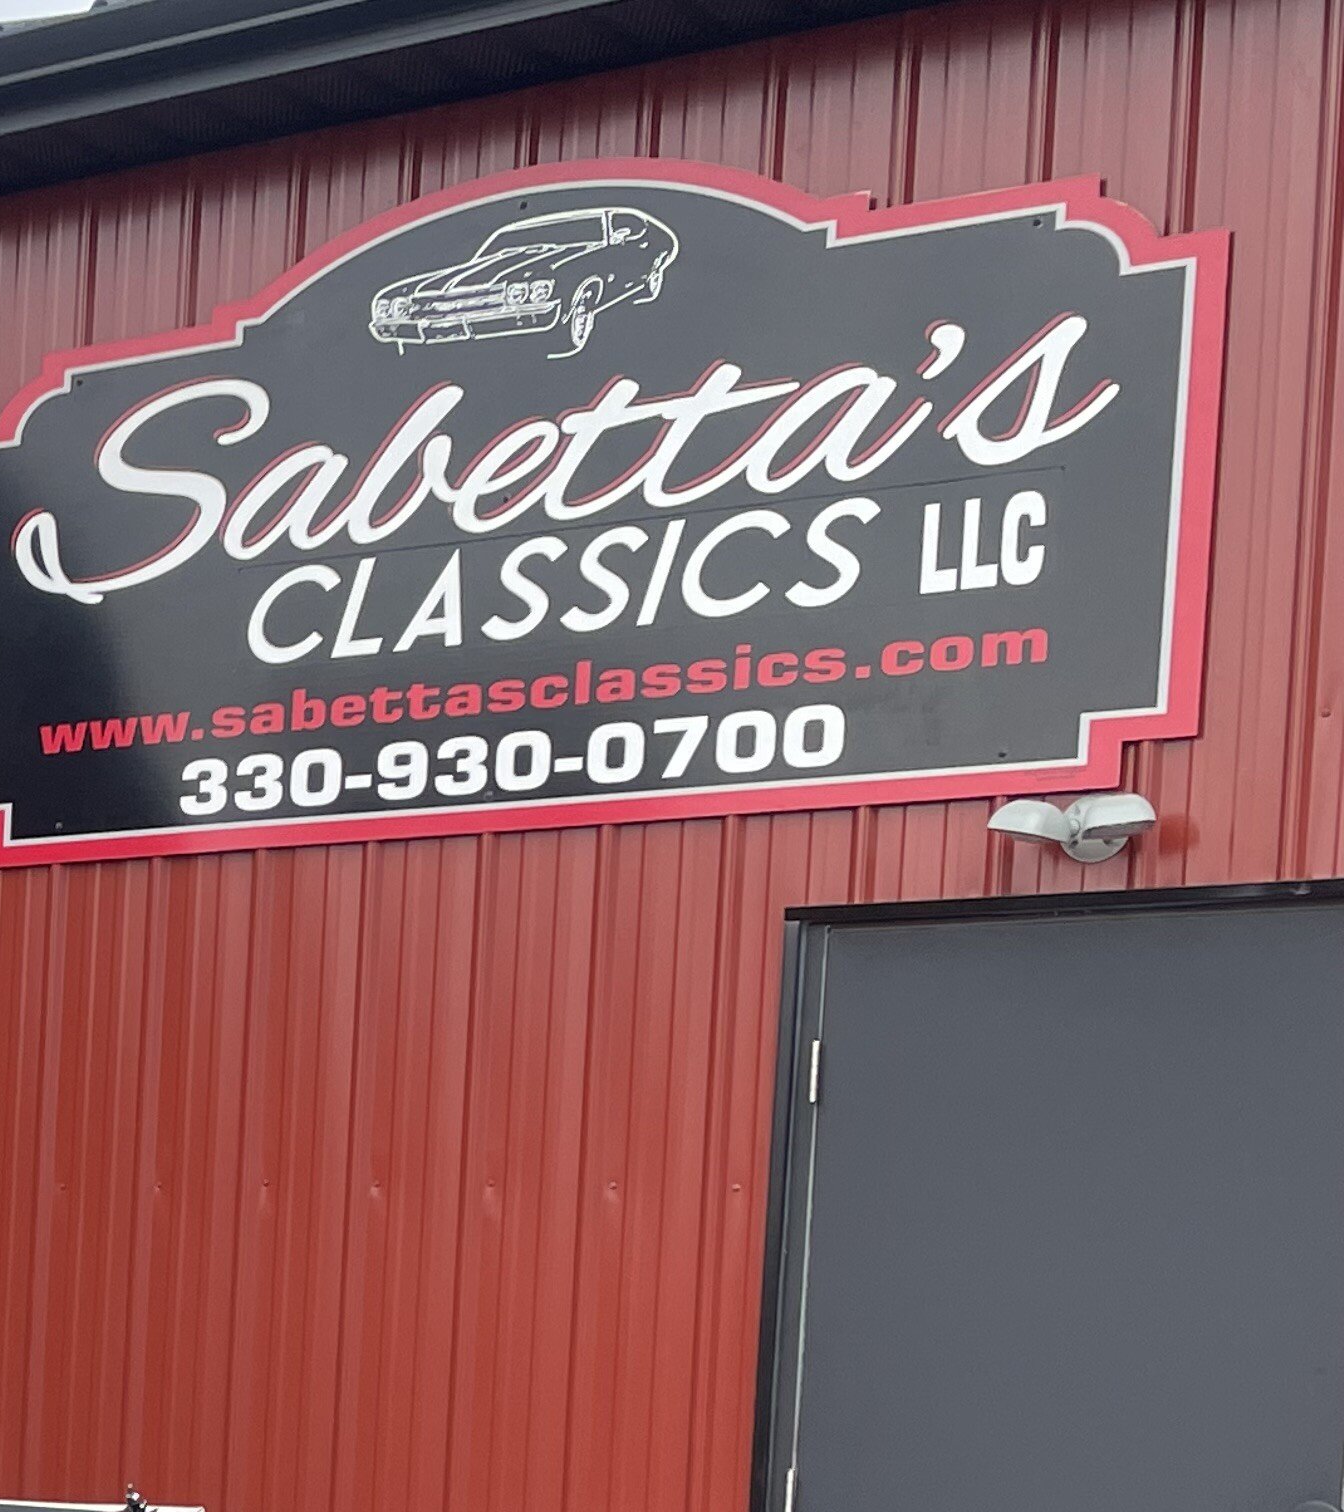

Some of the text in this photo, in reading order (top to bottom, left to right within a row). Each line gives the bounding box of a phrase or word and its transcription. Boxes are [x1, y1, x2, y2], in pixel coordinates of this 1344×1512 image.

[12, 311, 1121, 604] Sabetta's
[247, 490, 1048, 666] CLASSICS LLC
[39, 621, 1051, 756] www.sabettasclassics.com
[178, 703, 846, 818] 330-930-0700
